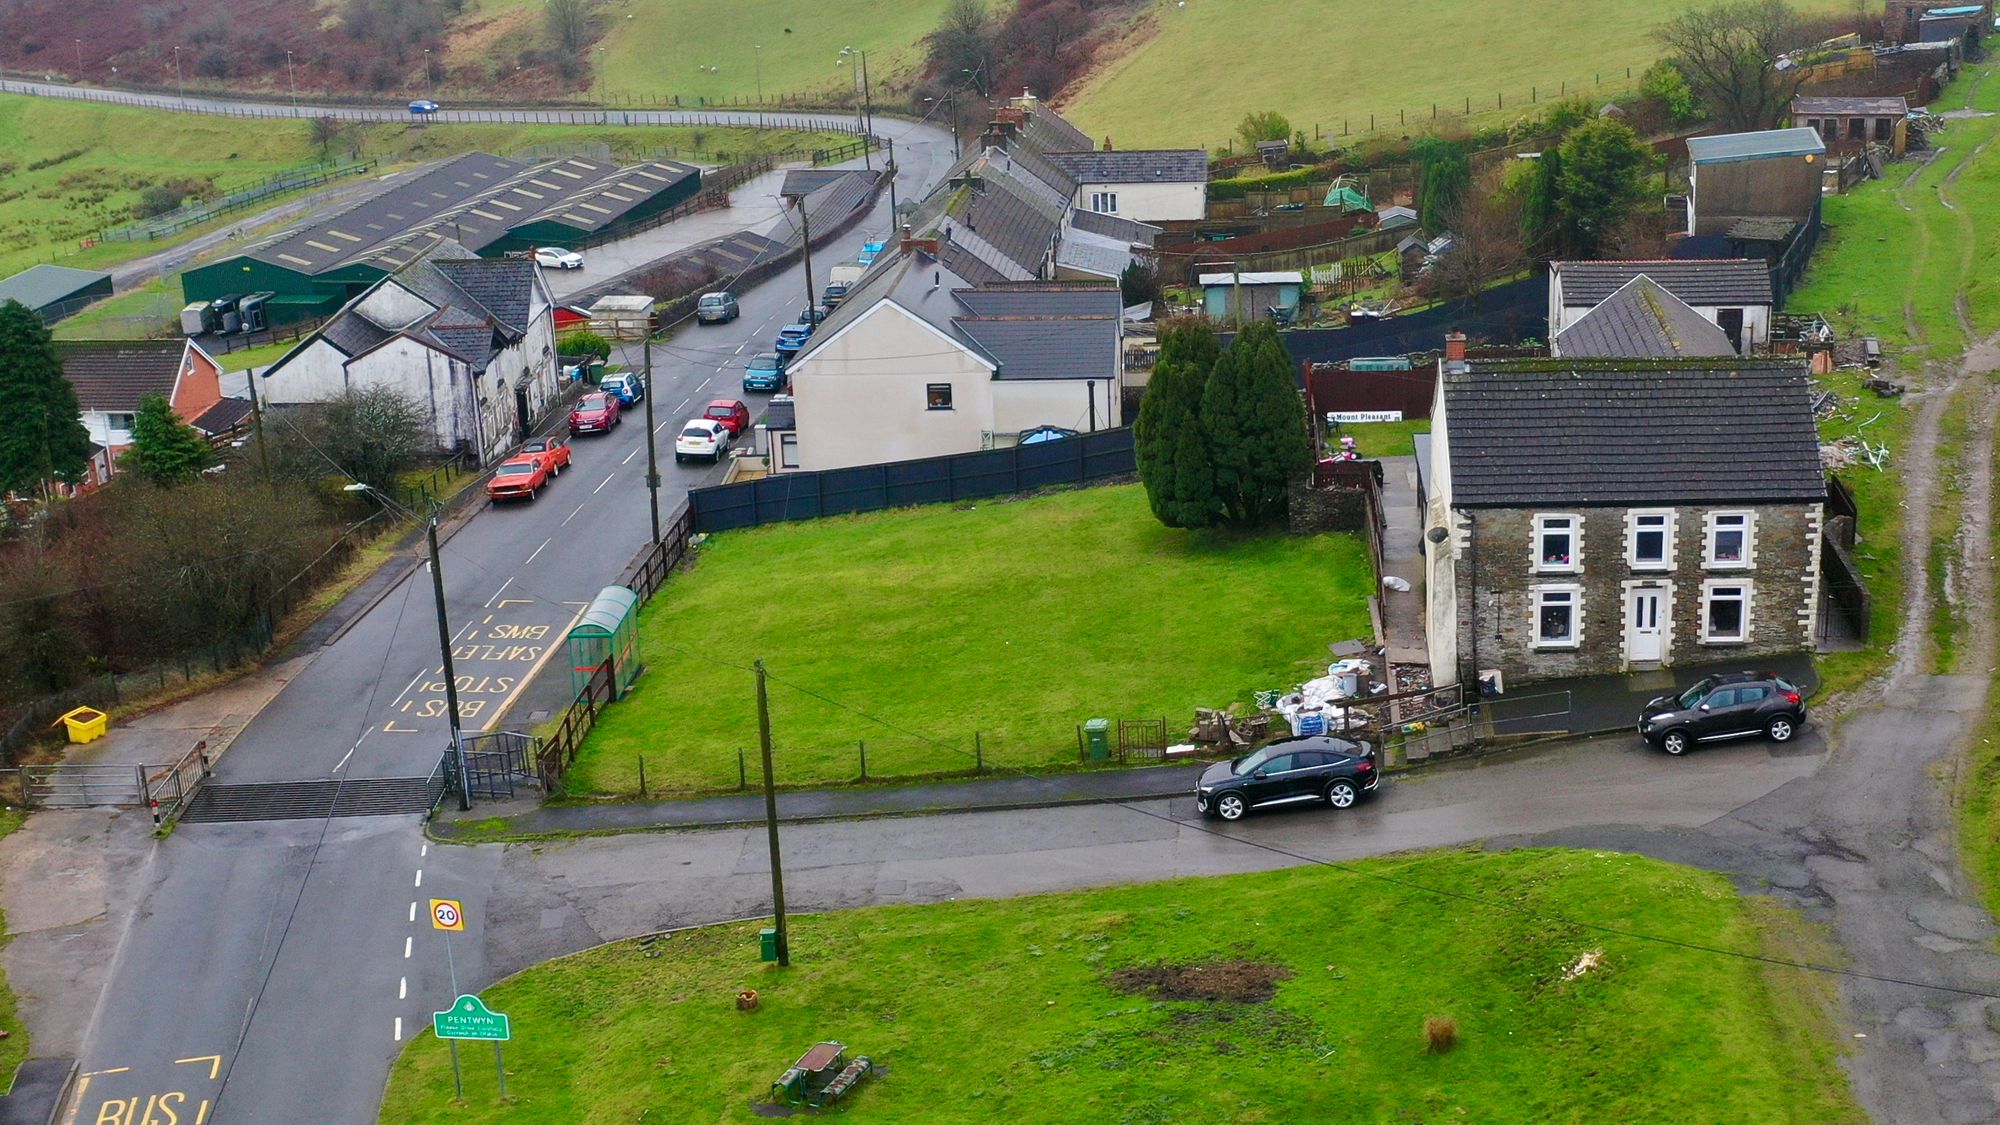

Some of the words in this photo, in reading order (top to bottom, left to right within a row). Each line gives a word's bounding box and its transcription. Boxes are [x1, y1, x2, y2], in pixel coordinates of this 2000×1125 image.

[488, 624, 549, 640] BWS
[454, 644, 542, 661] SAFLE
[416, 699, 486, 718] BUS
[437, 909, 455, 921] 20
[447, 1016, 494, 1025] PENTWYN
[95, 1091, 186, 1125] BUS
